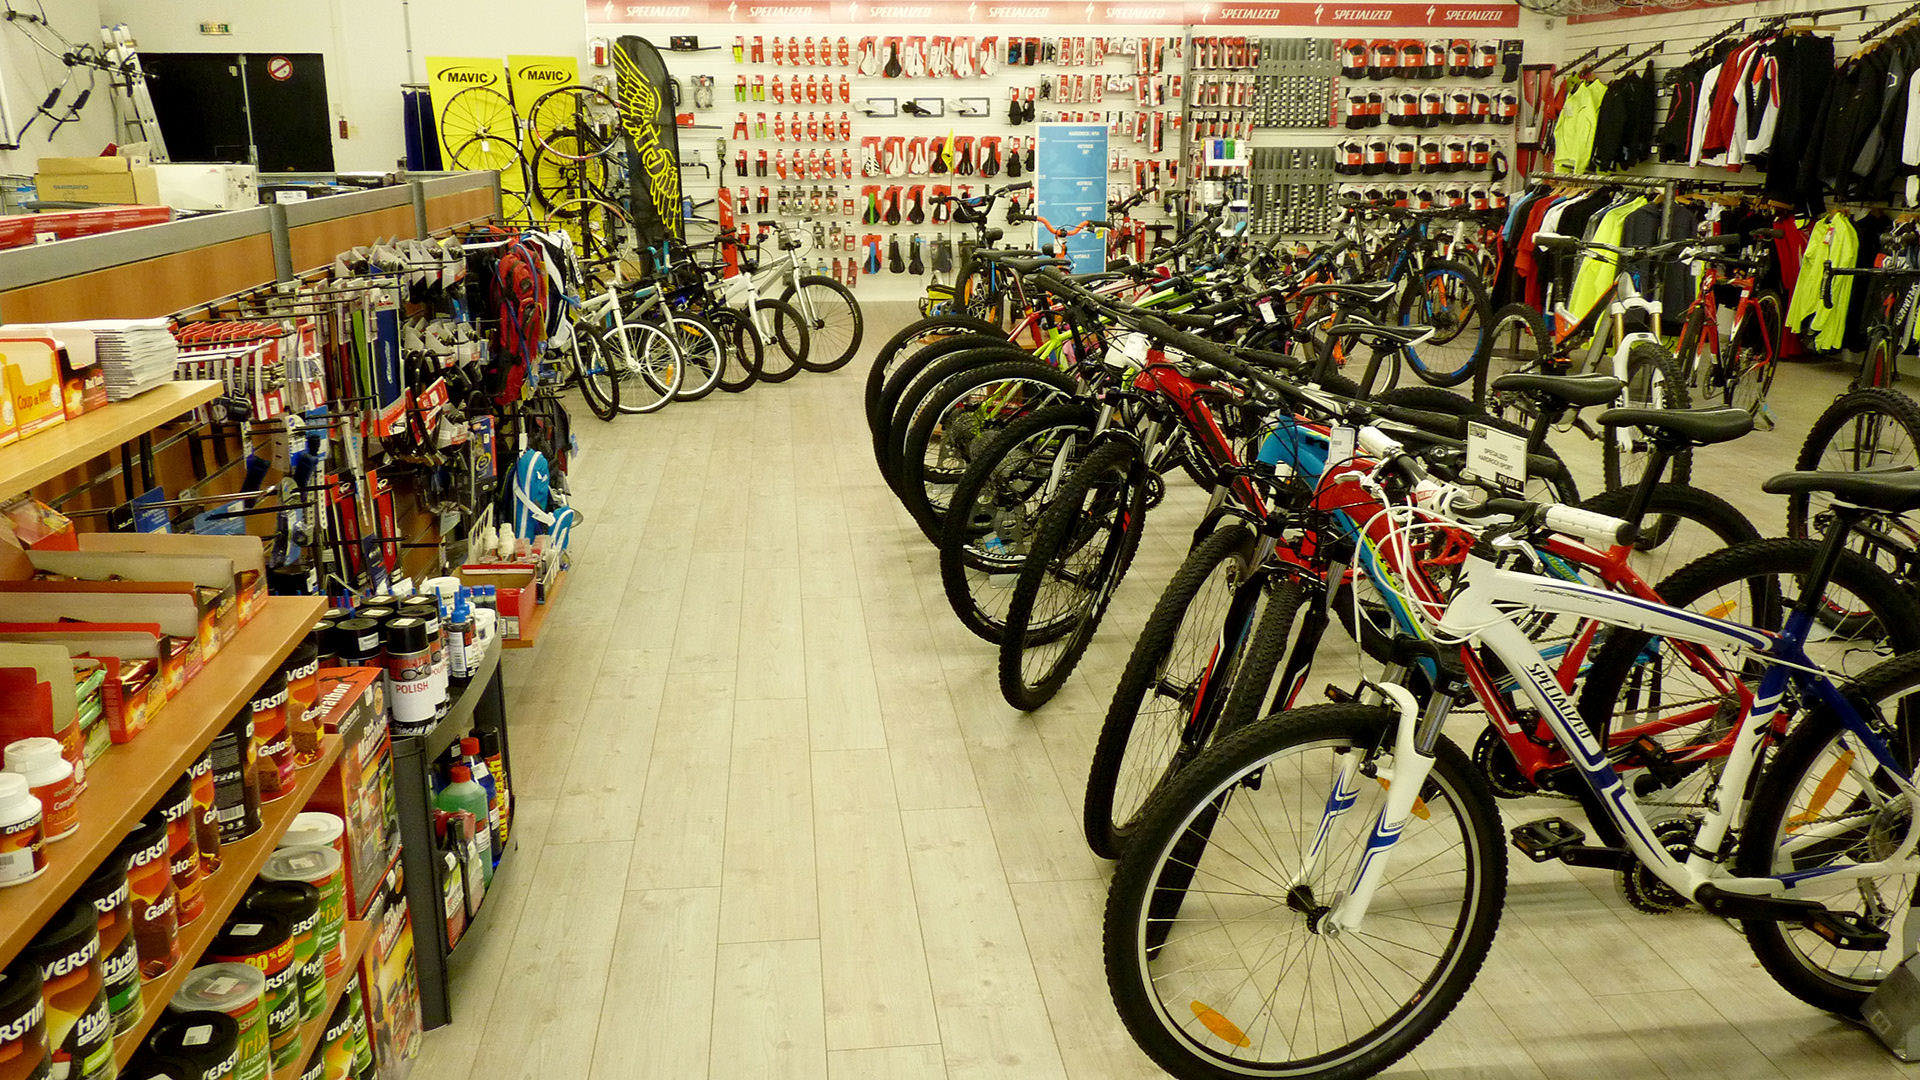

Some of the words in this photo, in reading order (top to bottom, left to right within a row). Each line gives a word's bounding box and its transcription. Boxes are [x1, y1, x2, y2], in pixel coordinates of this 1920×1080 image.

[625, 6, 690, 17] SPECIALIZED
[747, 6, 813, 17] SPECIALIZED
[869, 6, 932, 18] SPECIALIZED
[987, 6, 1051, 18] SPECIALIZED
[1105, 7, 1166, 19] SPECIALIZED
[1218, 8, 1281, 19] SPECIALIZED
[1333, 9, 1394, 21] SPECIALIZED
[1444, 9, 1503, 21] SPECIALIZED
[447, 72, 489, 83] MAVIC
[527, 70, 564, 81] MAVIC
[1526, 662, 1592, 739] SPECIALIZED
